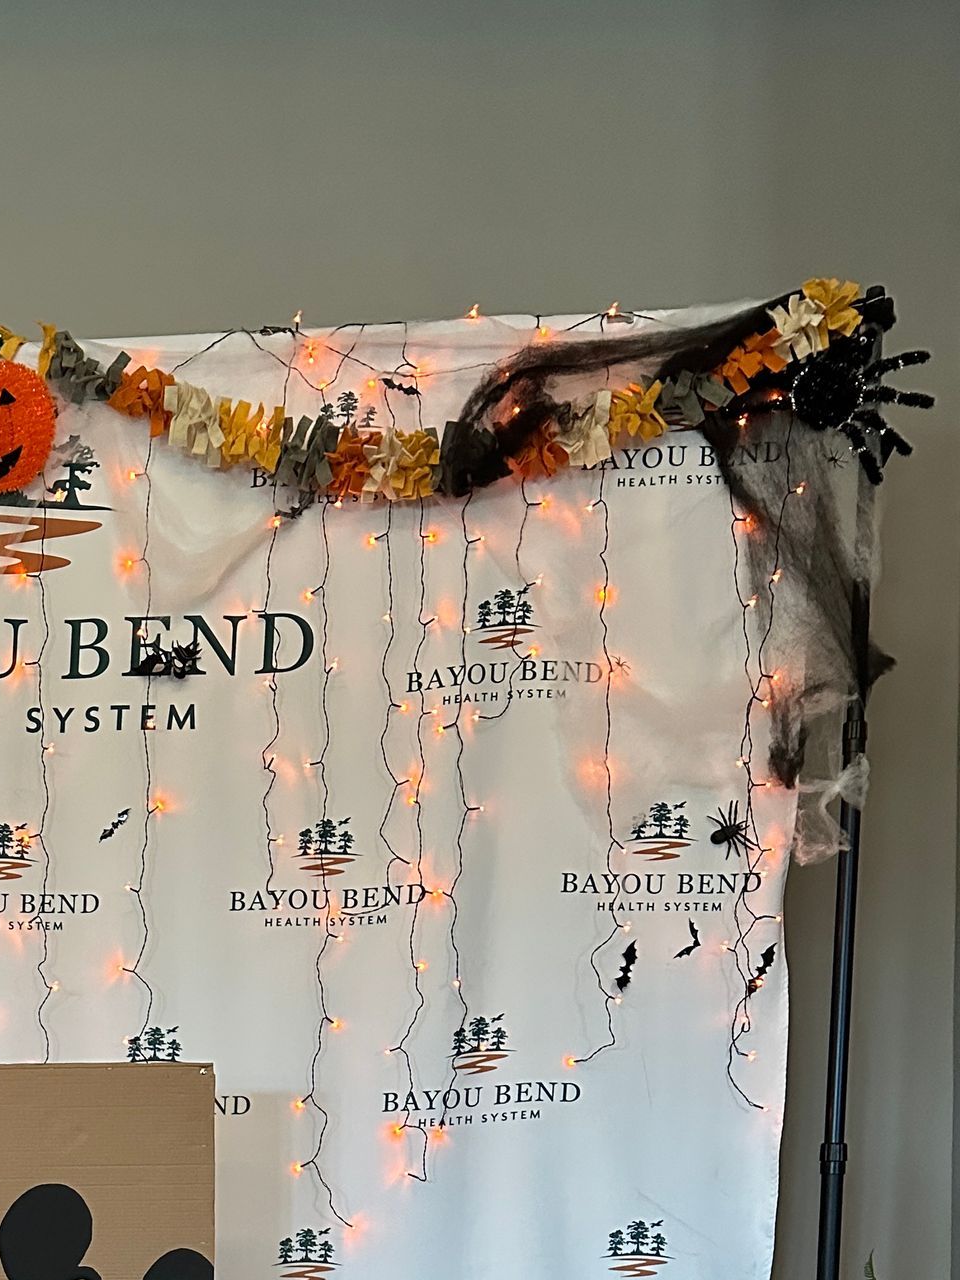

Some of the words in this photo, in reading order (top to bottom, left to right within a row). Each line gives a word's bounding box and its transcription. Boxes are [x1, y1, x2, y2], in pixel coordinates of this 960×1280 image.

[699, 441, 781, 466] BND
[617, 475, 677, 487] HEALTH
[687, 475, 732, 485] SYST
[62, 612, 315, 679] BEND
[406, 662, 509, 693] BAYOU
[520, 660, 603, 683] BEND
[443, 692, 498, 705] HEALTH
[507, 689, 566, 699] SYSTEM
[26, 704, 196, 734] SYSTEM
[561, 873, 666, 894] BAYOU
[677, 872, 762, 895] BEND
[20, 894, 99, 913] BEND
[229, 889, 330, 911] BAYOU
[342, 884, 426, 909] BEND
[597, 902, 655, 912] HEALTH
[665, 902, 722, 912] SYSTEM
[9, 921, 63, 931] SYSTEM
[265, 917, 321, 927] HEALTH
[330, 915, 387, 926] SYSTEM
[214, 1096, 251, 1115] ND
[382, 1087, 483, 1113] BAYOU
[494, 1082, 581, 1105] BEND
[419, 1115, 473, 1128] HEALTH
[481, 1110, 541, 1123] SYSTEM
